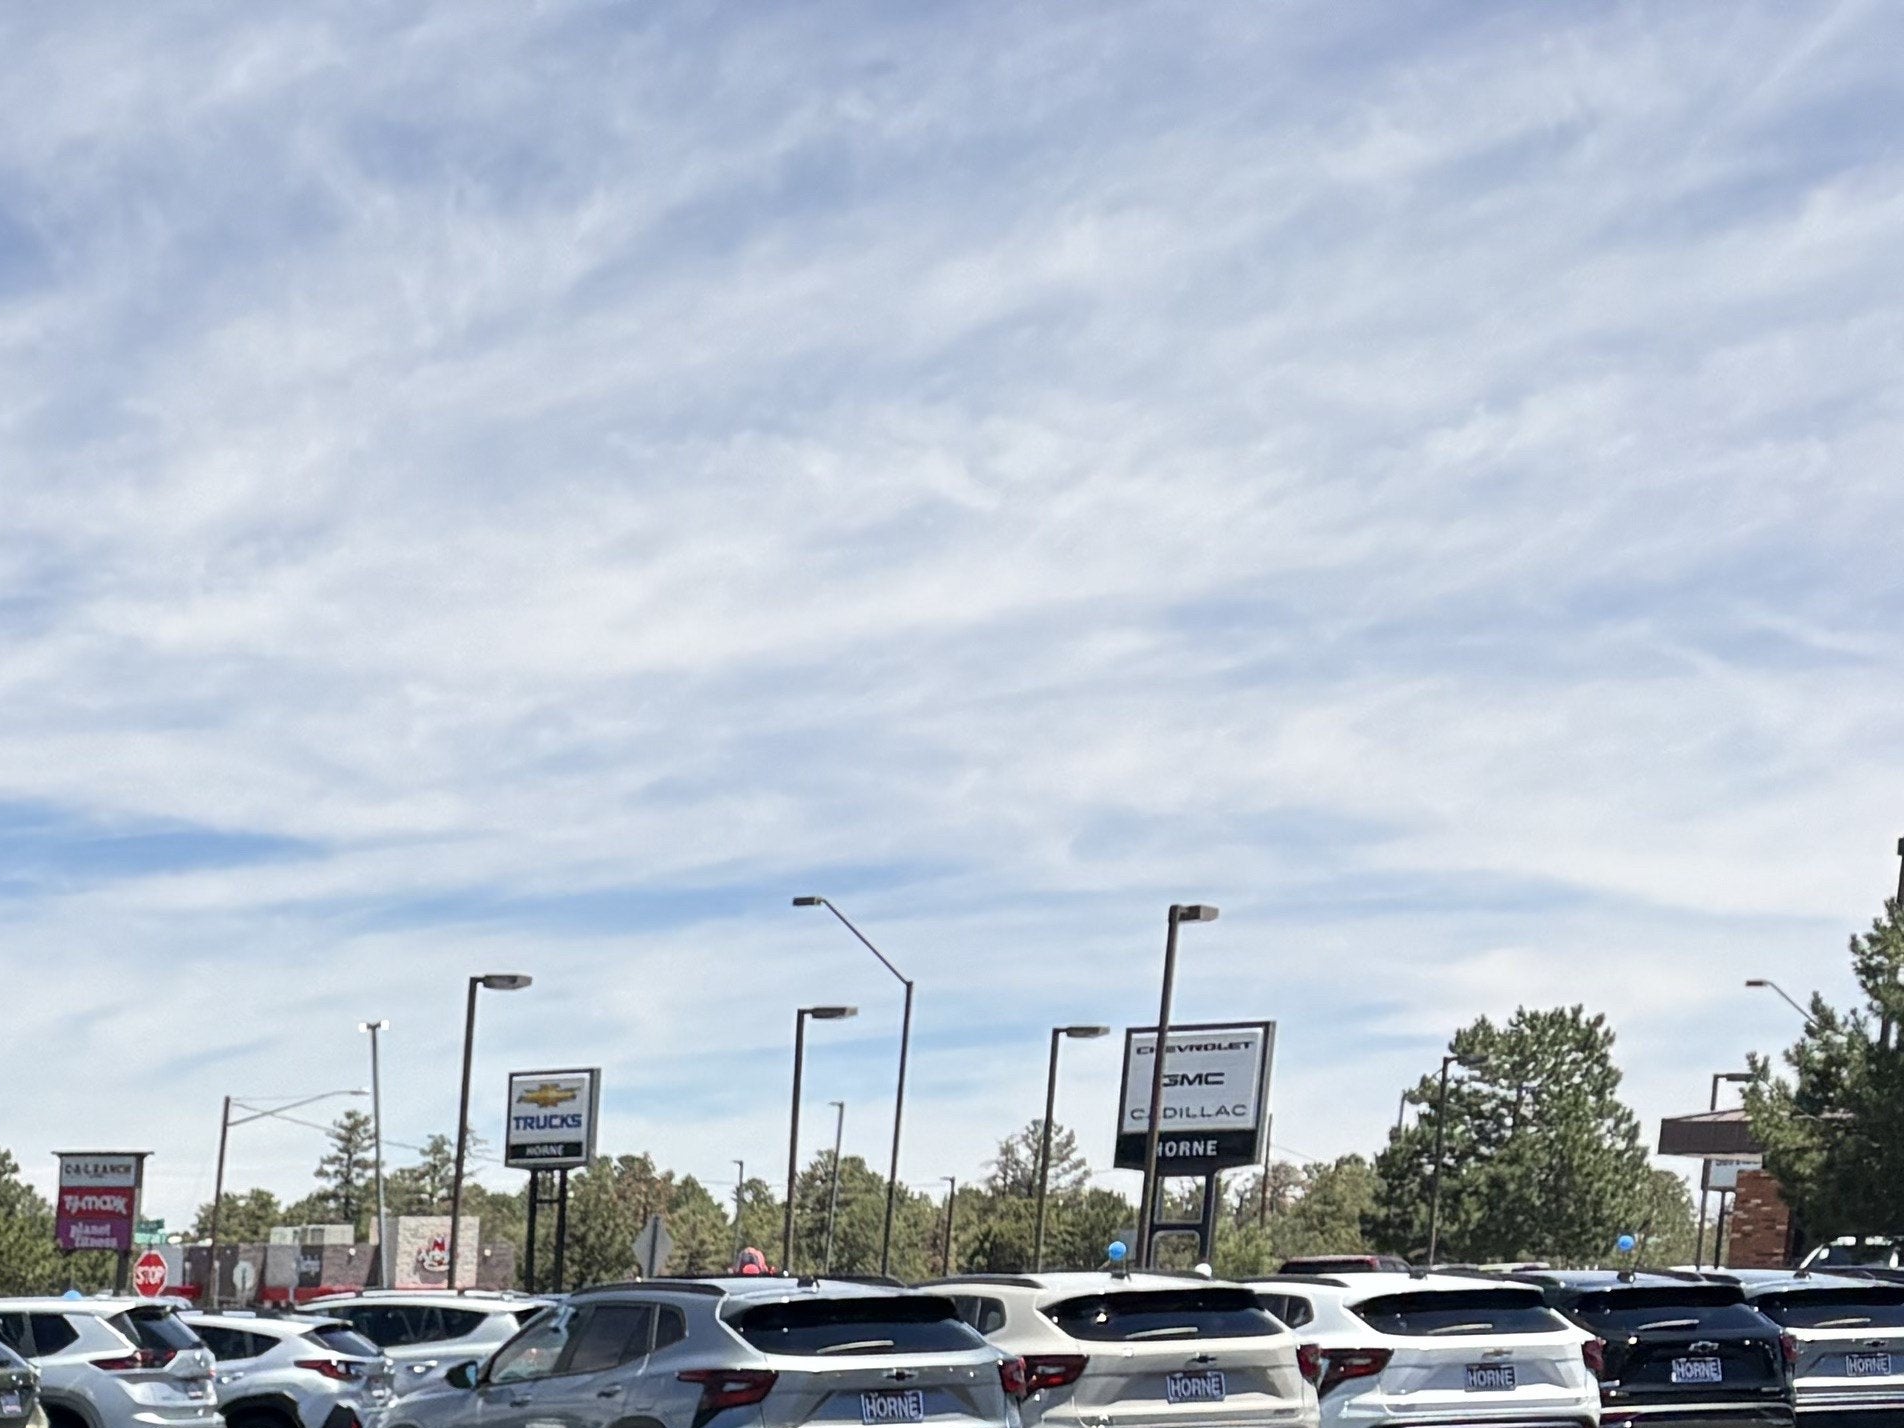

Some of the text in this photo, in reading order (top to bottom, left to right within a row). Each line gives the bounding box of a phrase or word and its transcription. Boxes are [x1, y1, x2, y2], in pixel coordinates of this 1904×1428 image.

[1130, 1104, 1247, 1121] CDILLAC
[513, 1113, 583, 1131] TRUCKS
[525, 1144, 565, 1156] HORNE
[136, 1265, 166, 1285] STOP
[1467, 1369, 1514, 1387] HORNE
[1676, 1361, 1719, 1378] HORNE
[1171, 1377, 1221, 1397] HORNE
[866, 1395, 919, 1420] HORNE
